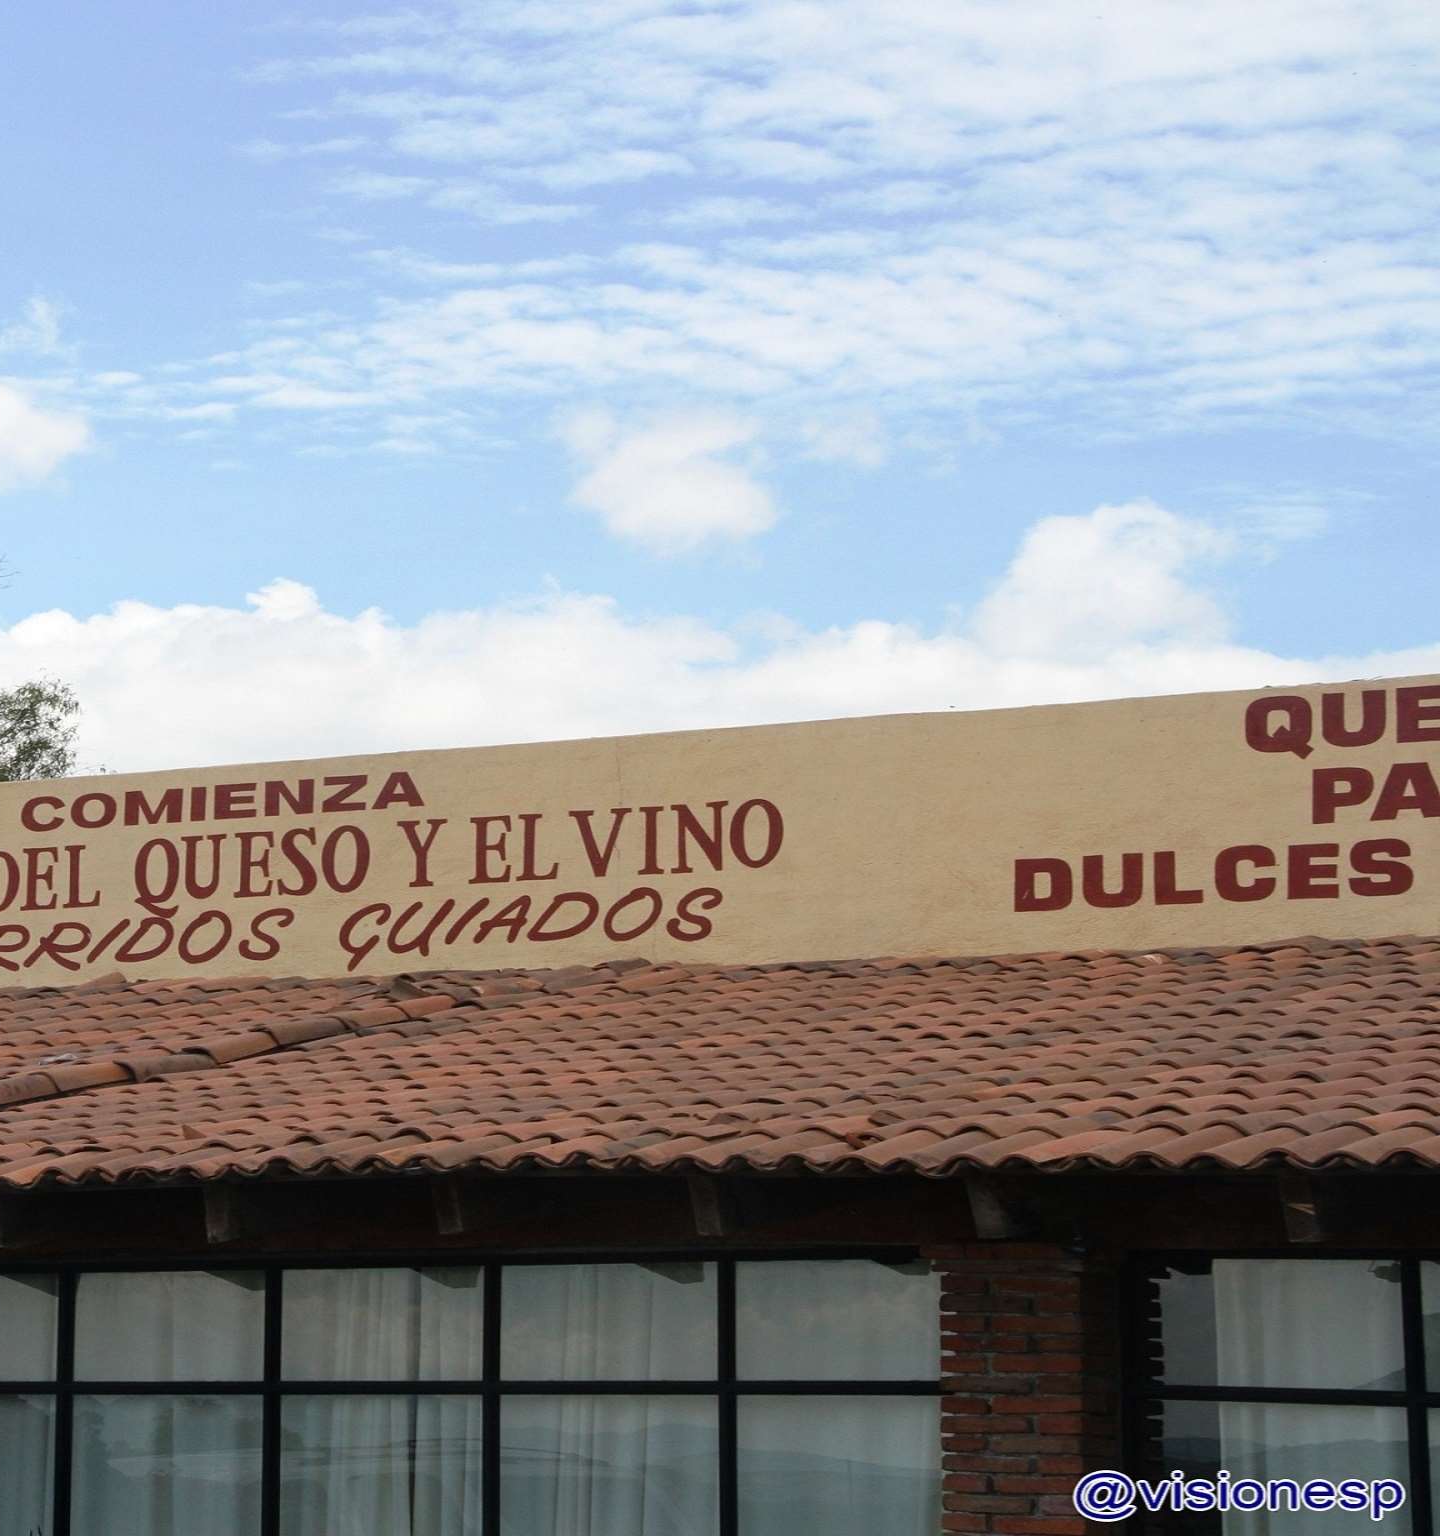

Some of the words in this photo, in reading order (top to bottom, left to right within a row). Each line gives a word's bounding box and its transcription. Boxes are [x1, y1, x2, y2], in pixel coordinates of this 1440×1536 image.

[20, 771, 425, 832] COMIENZA
[1312, 762, 1440, 824] PA
[133, 824, 371, 914] QUESO
[397, 818, 447, 888] Y
[468, 813, 559, 884] EL
[568, 799, 784, 878] VINO
[1014, 838, 1415, 912] DULCES
[338, 886, 723, 972] GUIADOS
